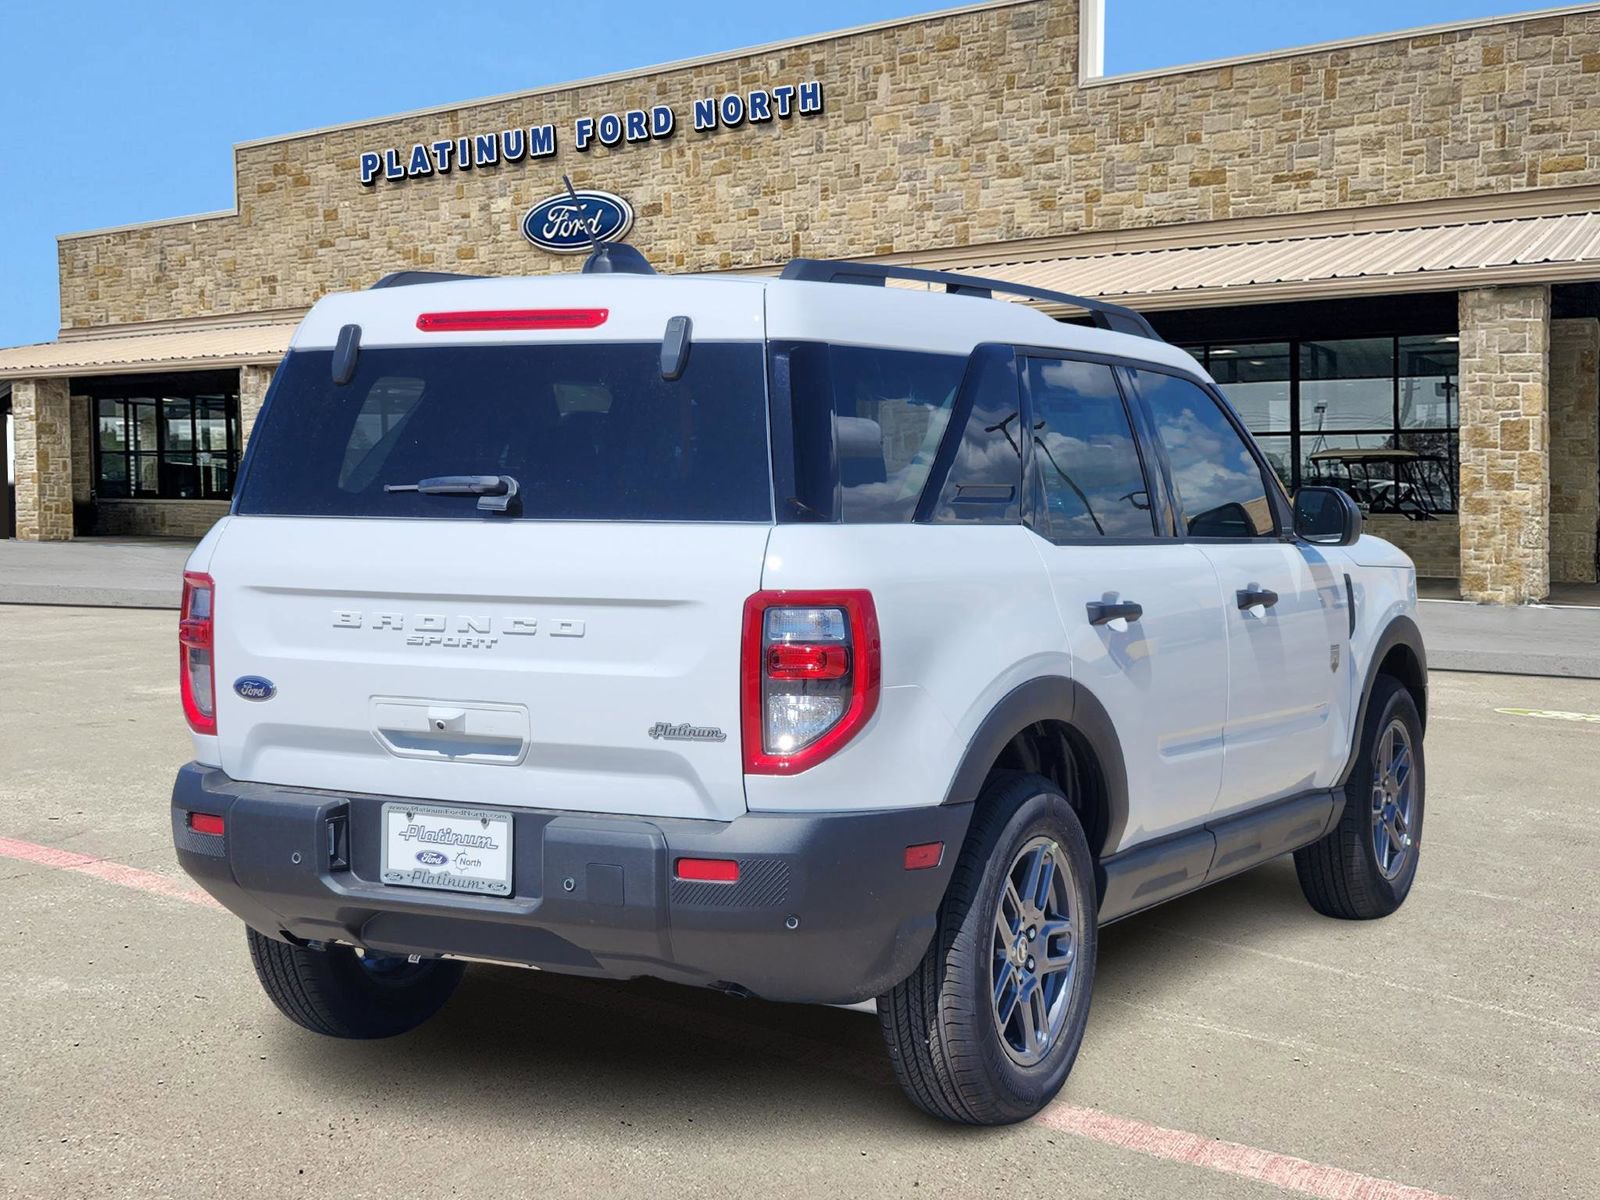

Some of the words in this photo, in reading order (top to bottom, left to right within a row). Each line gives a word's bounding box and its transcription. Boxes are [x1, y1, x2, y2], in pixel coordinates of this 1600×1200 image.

[360, 124, 556, 185] PLATINUM
[575, 105, 674, 151] FORD
[694, 81, 823, 130] NORTH
[543, 204, 602, 239] Ford
[332, 610, 586, 637] BRONCO
[406, 635, 498, 649] SPORT
[648, 721, 727, 742] Platinum
[398, 825, 499, 849] Platinum
[459, 857, 482, 868] North
[411, 870, 484, 889] Platinum
